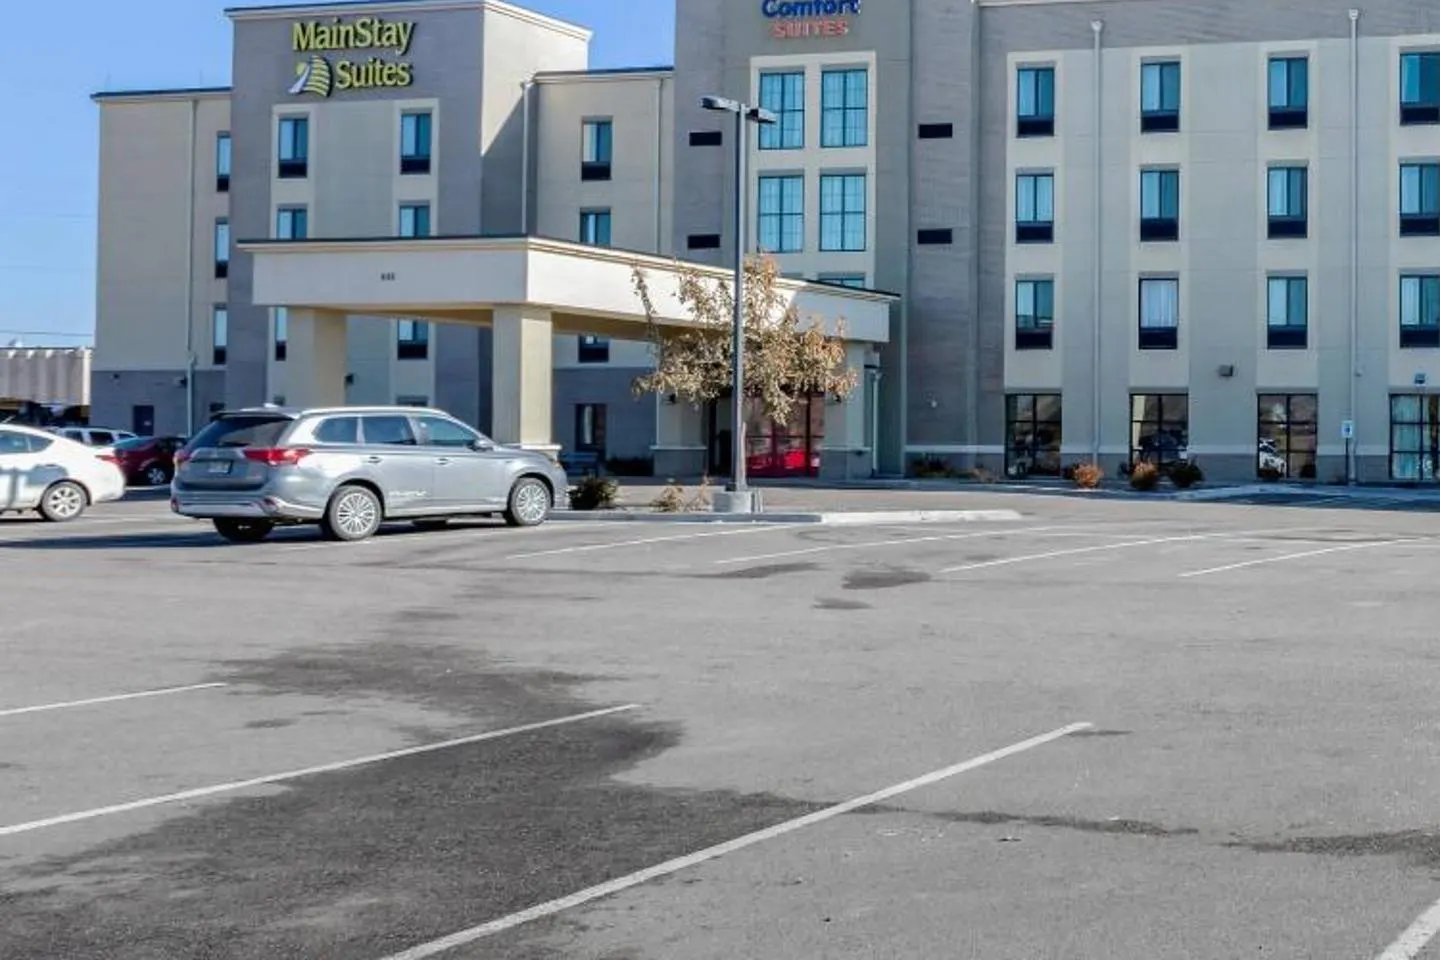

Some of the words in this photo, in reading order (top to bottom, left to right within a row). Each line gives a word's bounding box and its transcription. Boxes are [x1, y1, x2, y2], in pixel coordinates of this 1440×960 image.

[293, 17, 416, 55] MainStay
[771, 18, 849, 38] SUITES
[336, 57, 413, 89] Suites
